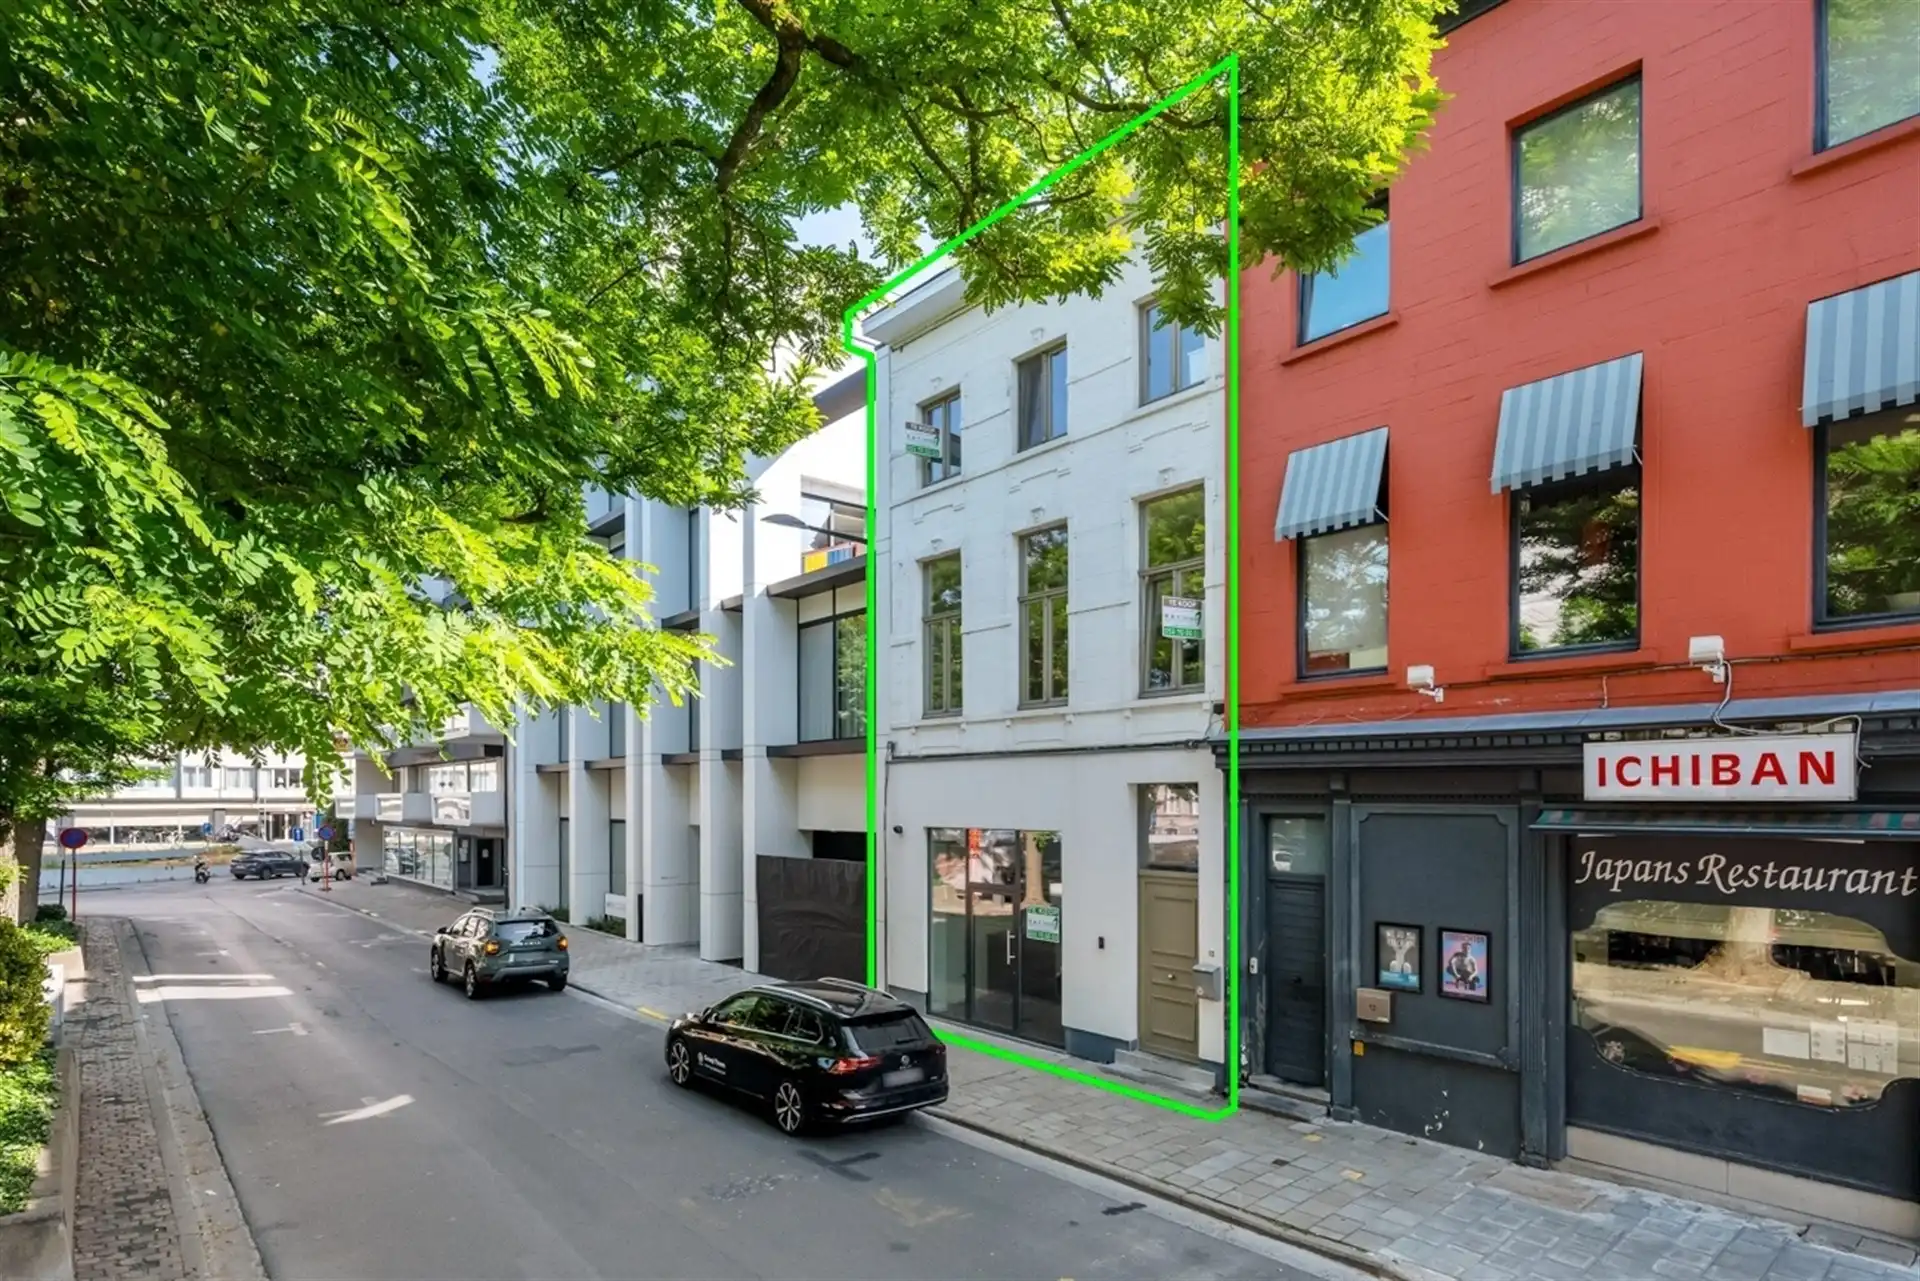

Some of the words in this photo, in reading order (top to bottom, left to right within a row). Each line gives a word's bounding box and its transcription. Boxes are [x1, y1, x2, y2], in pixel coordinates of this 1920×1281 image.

[1598, 752, 1835, 787] ICHIBAN
[1575, 852, 1690, 892] Japans
[1696, 854, 1917, 896] Restaurant
